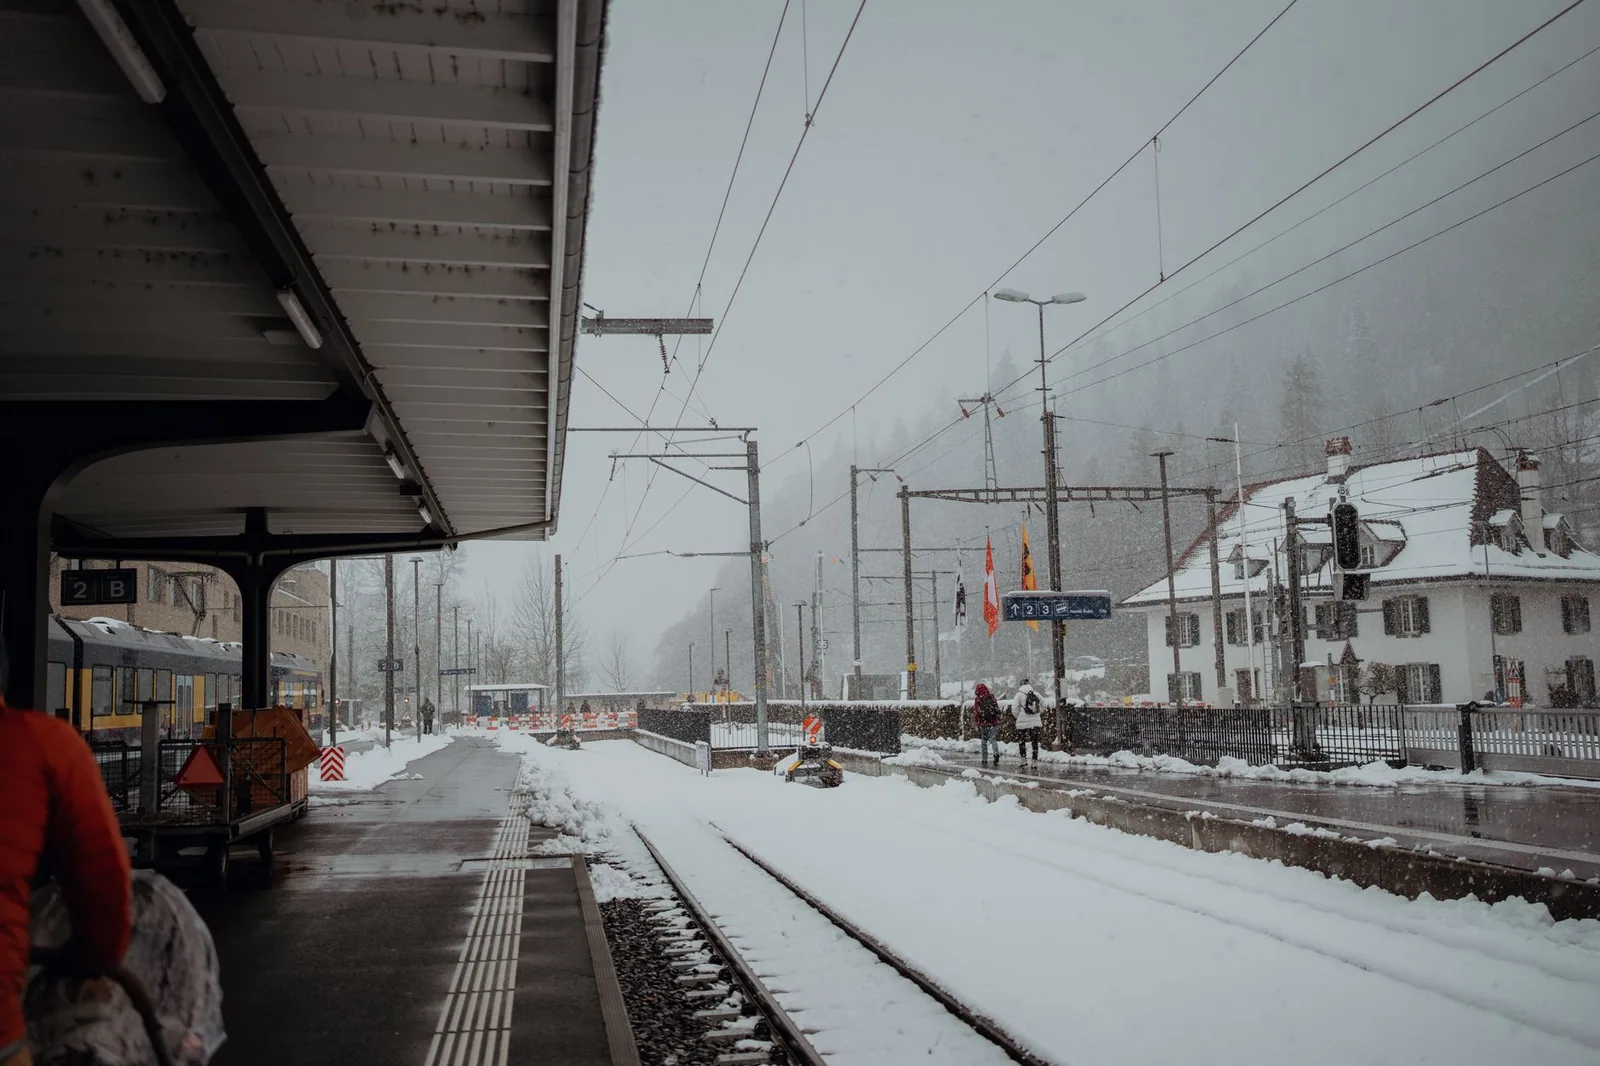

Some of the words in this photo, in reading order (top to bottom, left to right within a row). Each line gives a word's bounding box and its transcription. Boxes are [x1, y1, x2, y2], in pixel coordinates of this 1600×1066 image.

[73, 581, 87, 599] 2
[110, 580, 125, 598] B
[1026, 605, 1034, 615] 2
[1042, 605, 1050, 615] 3
